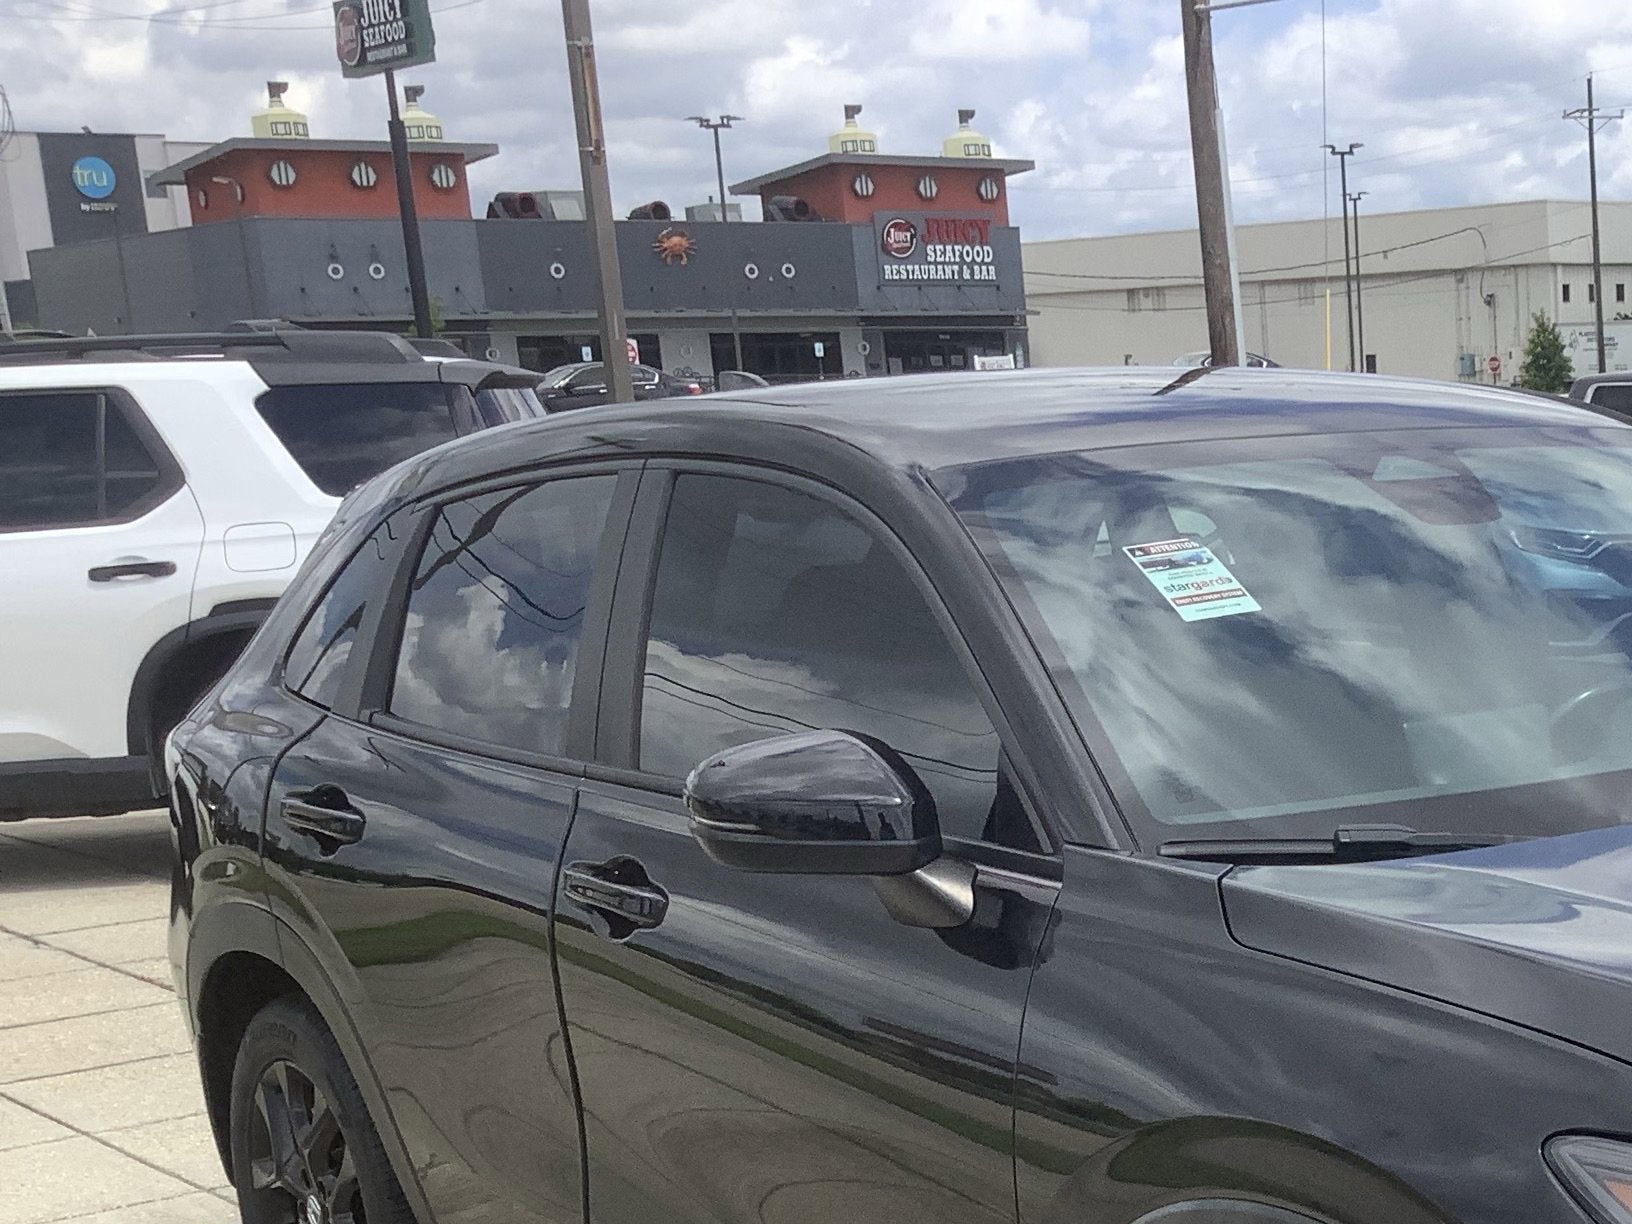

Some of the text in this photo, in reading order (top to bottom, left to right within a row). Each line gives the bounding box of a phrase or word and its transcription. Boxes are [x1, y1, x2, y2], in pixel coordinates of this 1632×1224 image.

[363, 21, 406, 47] SEAFOOD
[73, 166, 107, 187] tru
[921, 219, 991, 244] JUICY
[926, 244, 993, 262] SEAFOOD
[884, 264, 997, 280] RESTAURANT & BAR
[1150, 541, 1200, 553] ATTENTION
